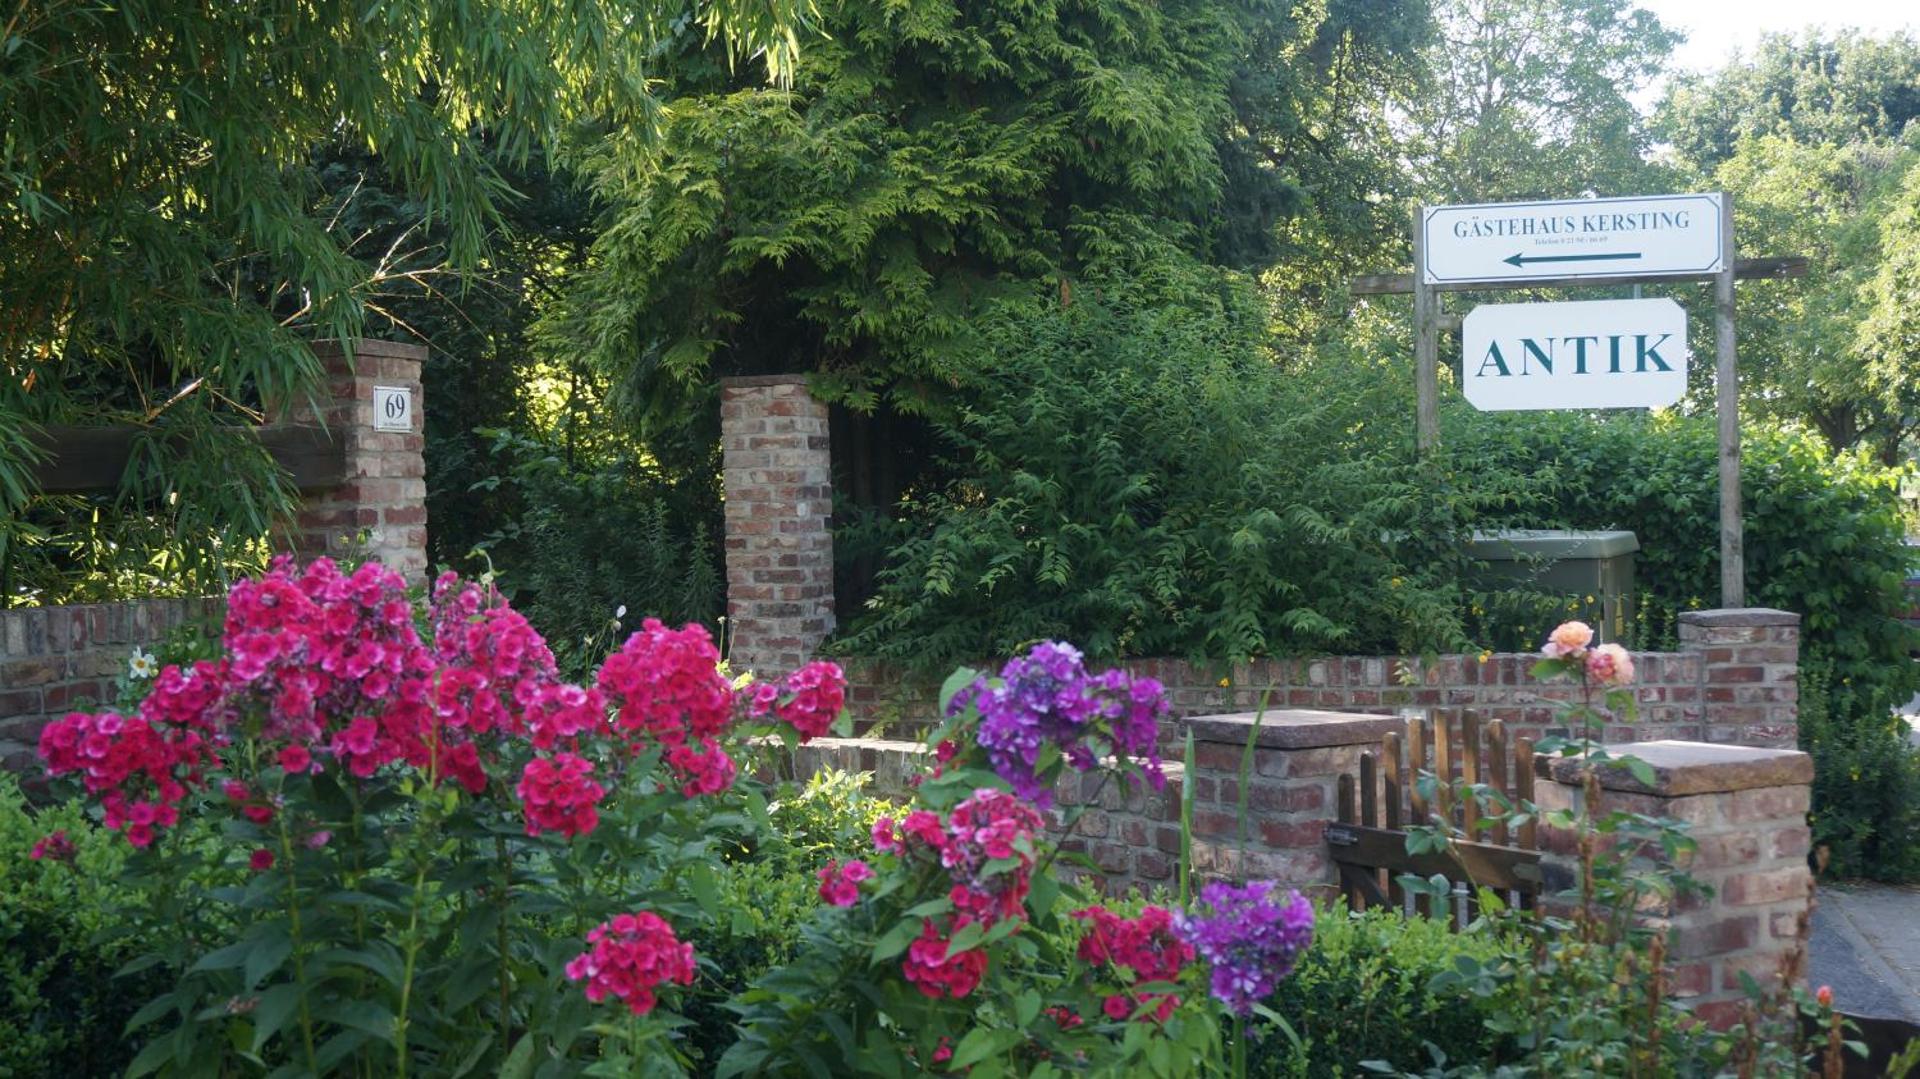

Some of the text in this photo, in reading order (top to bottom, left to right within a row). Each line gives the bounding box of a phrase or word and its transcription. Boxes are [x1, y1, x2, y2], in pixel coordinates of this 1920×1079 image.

[1454, 211, 1690, 238] GÄSTEHAUS KERSTING
[1475, 333, 1675, 377] ANTIK
[385, 393, 405, 419] 69
